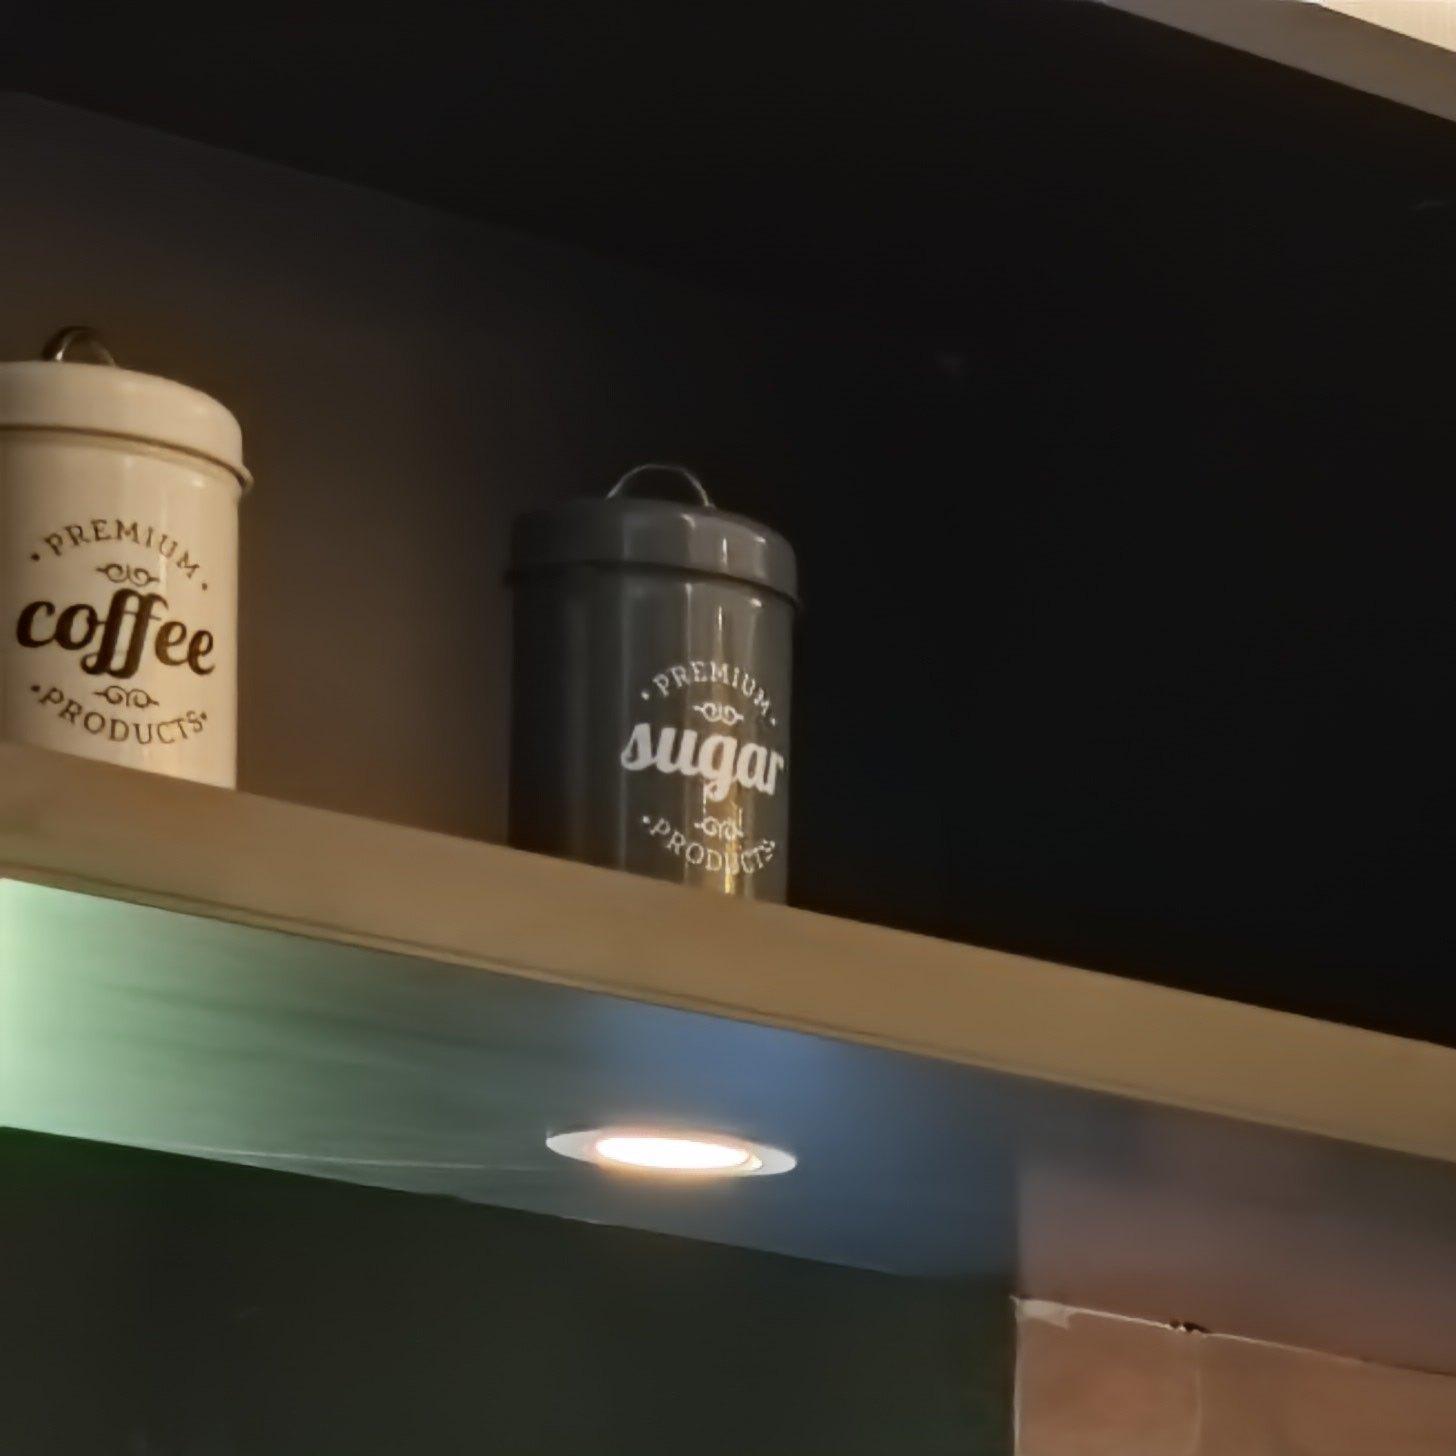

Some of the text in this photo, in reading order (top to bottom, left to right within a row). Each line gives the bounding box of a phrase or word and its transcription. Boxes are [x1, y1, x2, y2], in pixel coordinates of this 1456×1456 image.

[44, 518, 201, 579] PREMIUM
[16, 587, 216, 680] coffee
[38, 686, 205, 745] PRODUCTS
[652, 660, 770, 716] PREMIUM
[620, 722, 785, 802] sugar
[649, 817, 775, 875] PRODUCTS
